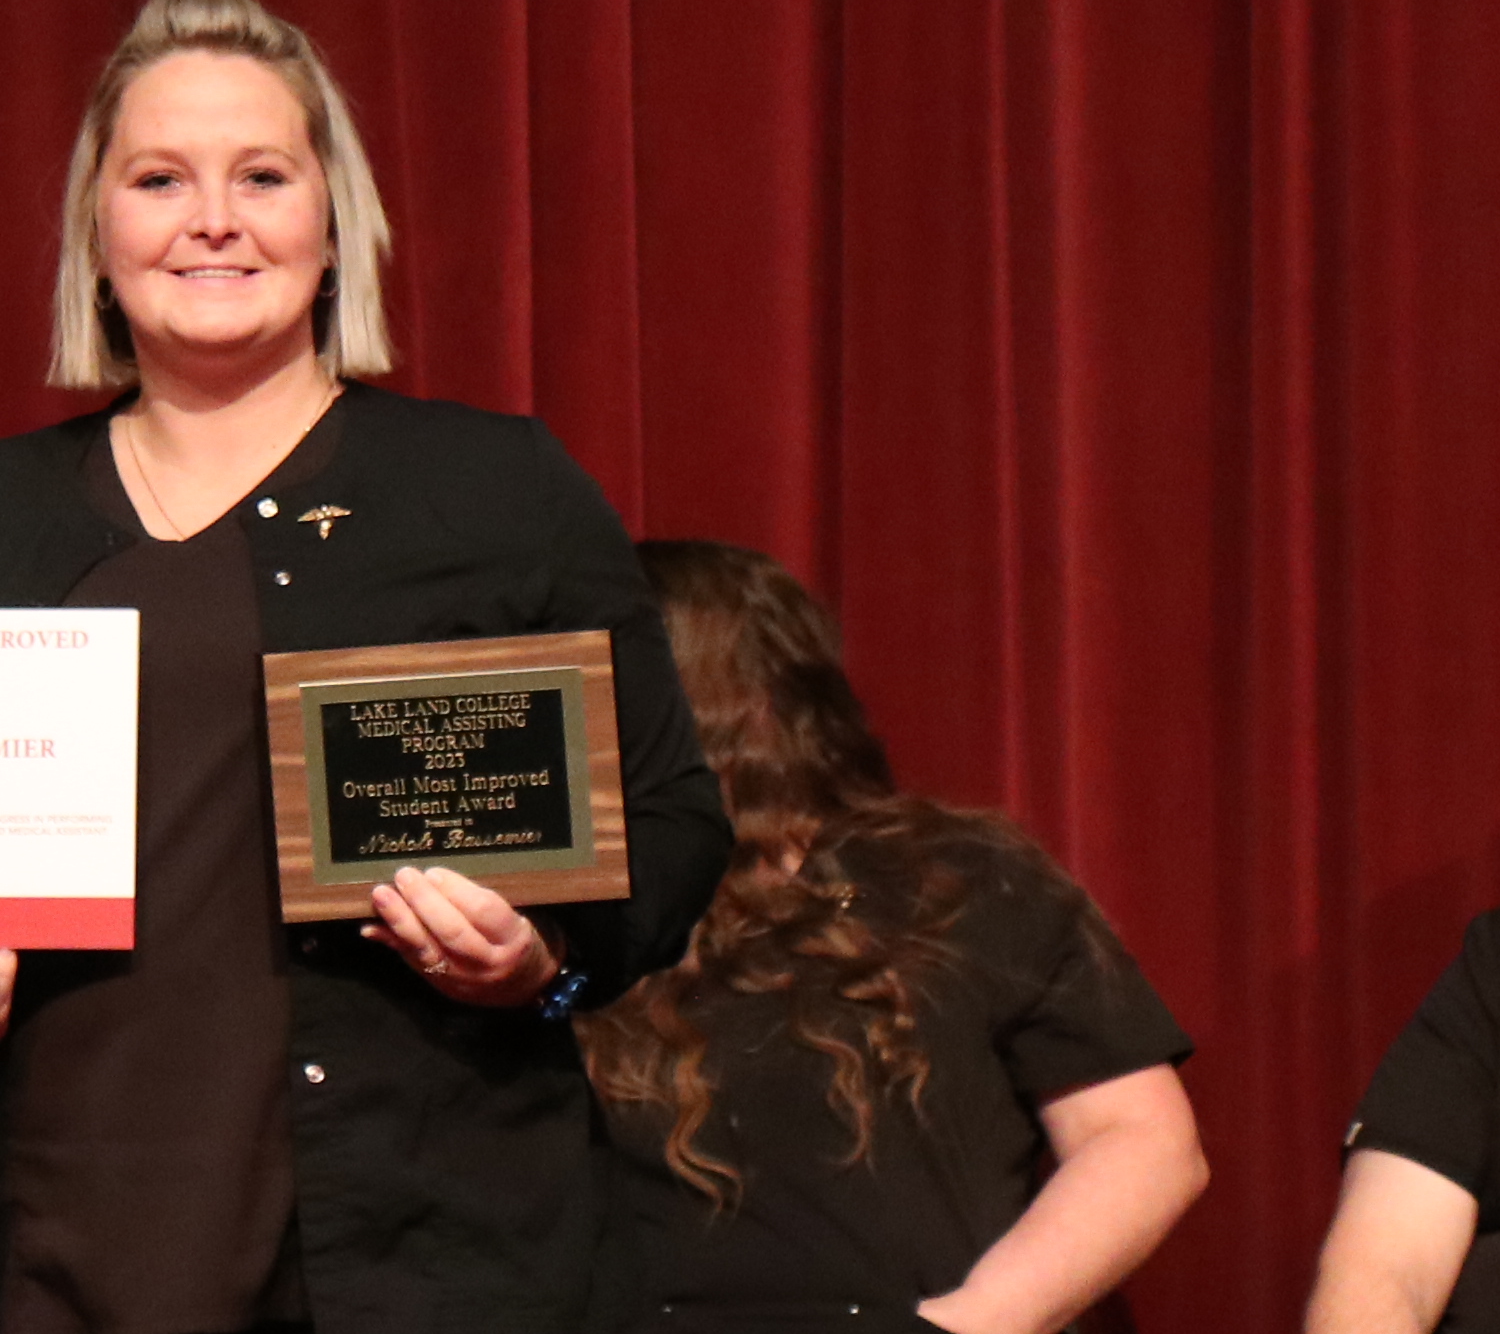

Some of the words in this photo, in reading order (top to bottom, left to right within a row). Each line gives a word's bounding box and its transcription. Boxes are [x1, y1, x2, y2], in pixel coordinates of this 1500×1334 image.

[351, 703, 398, 721] LAKE
[404, 700, 450, 717] LAND
[456, 694, 531, 713] COLLEGE
[358, 718, 434, 738] MEDICAL
[441, 713, 526, 732] ASSISTING
[402, 734, 485, 753] PROGRAM
[425, 754, 465, 770] 2023
[343, 779, 405, 798] Overall
[414, 775, 456, 794] Most
[464, 769, 550, 794] Improved
[379, 798, 449, 818] Student
[458, 793, 516, 812] Award
[359, 832, 434, 854] Nichole
